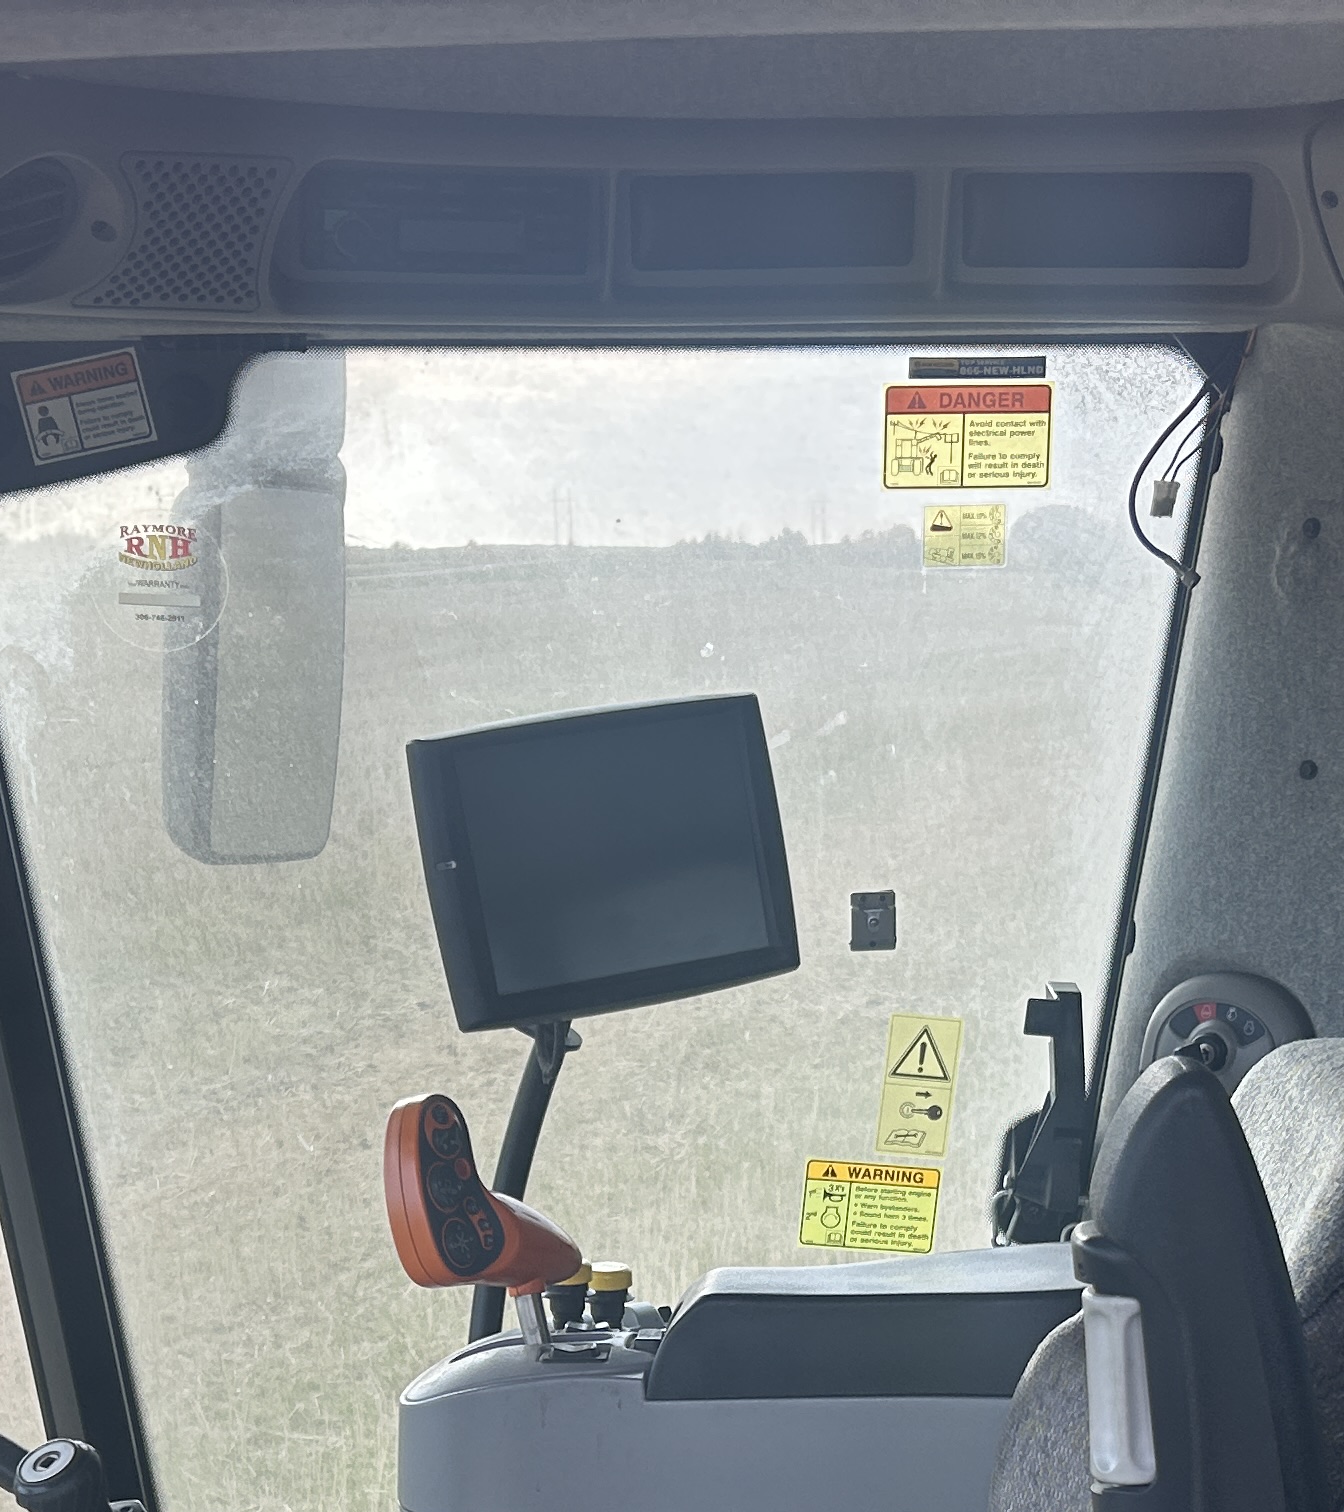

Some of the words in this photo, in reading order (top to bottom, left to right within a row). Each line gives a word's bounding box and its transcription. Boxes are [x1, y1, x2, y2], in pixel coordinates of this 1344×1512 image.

[47, 362, 128, 391] WARNING
[939, 391, 1025, 409] DANGER
[969, 429, 1006, 437] electrical
[1010, 430, 1035, 438] power
[1010, 453, 1040, 461] comply
[119, 524, 197, 542] RAYMORE
[124, 534, 192, 560] RNH
[847, 1166, 924, 1184] WARNING
[881, 1188, 906, 1196] starting
[852, 1221, 877, 1229] Failure
[890, 1225, 918, 1233] comply
